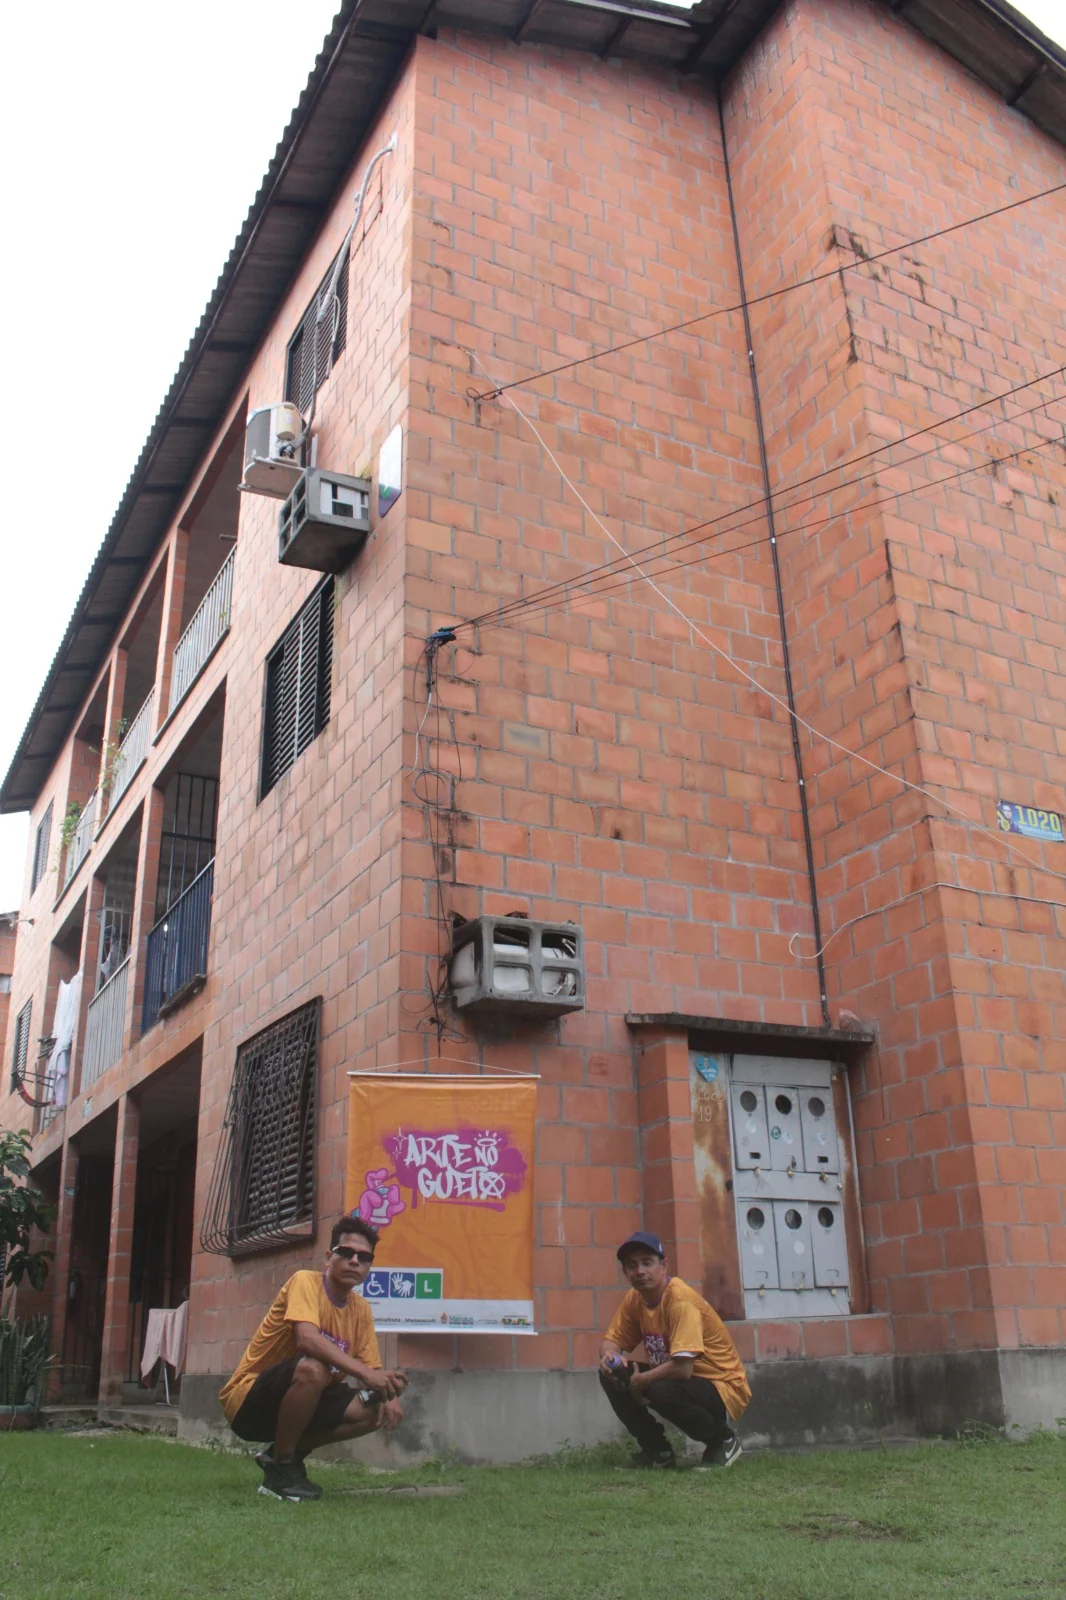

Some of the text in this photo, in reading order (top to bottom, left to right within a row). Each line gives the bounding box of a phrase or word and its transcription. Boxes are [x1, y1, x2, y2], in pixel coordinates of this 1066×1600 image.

[1015, 805, 1061, 832] 1020
[403, 1134, 499, 1169] ARTE NO
[417, 1164, 506, 1201] GUETO
[423, 1280, 433, 1293] L
